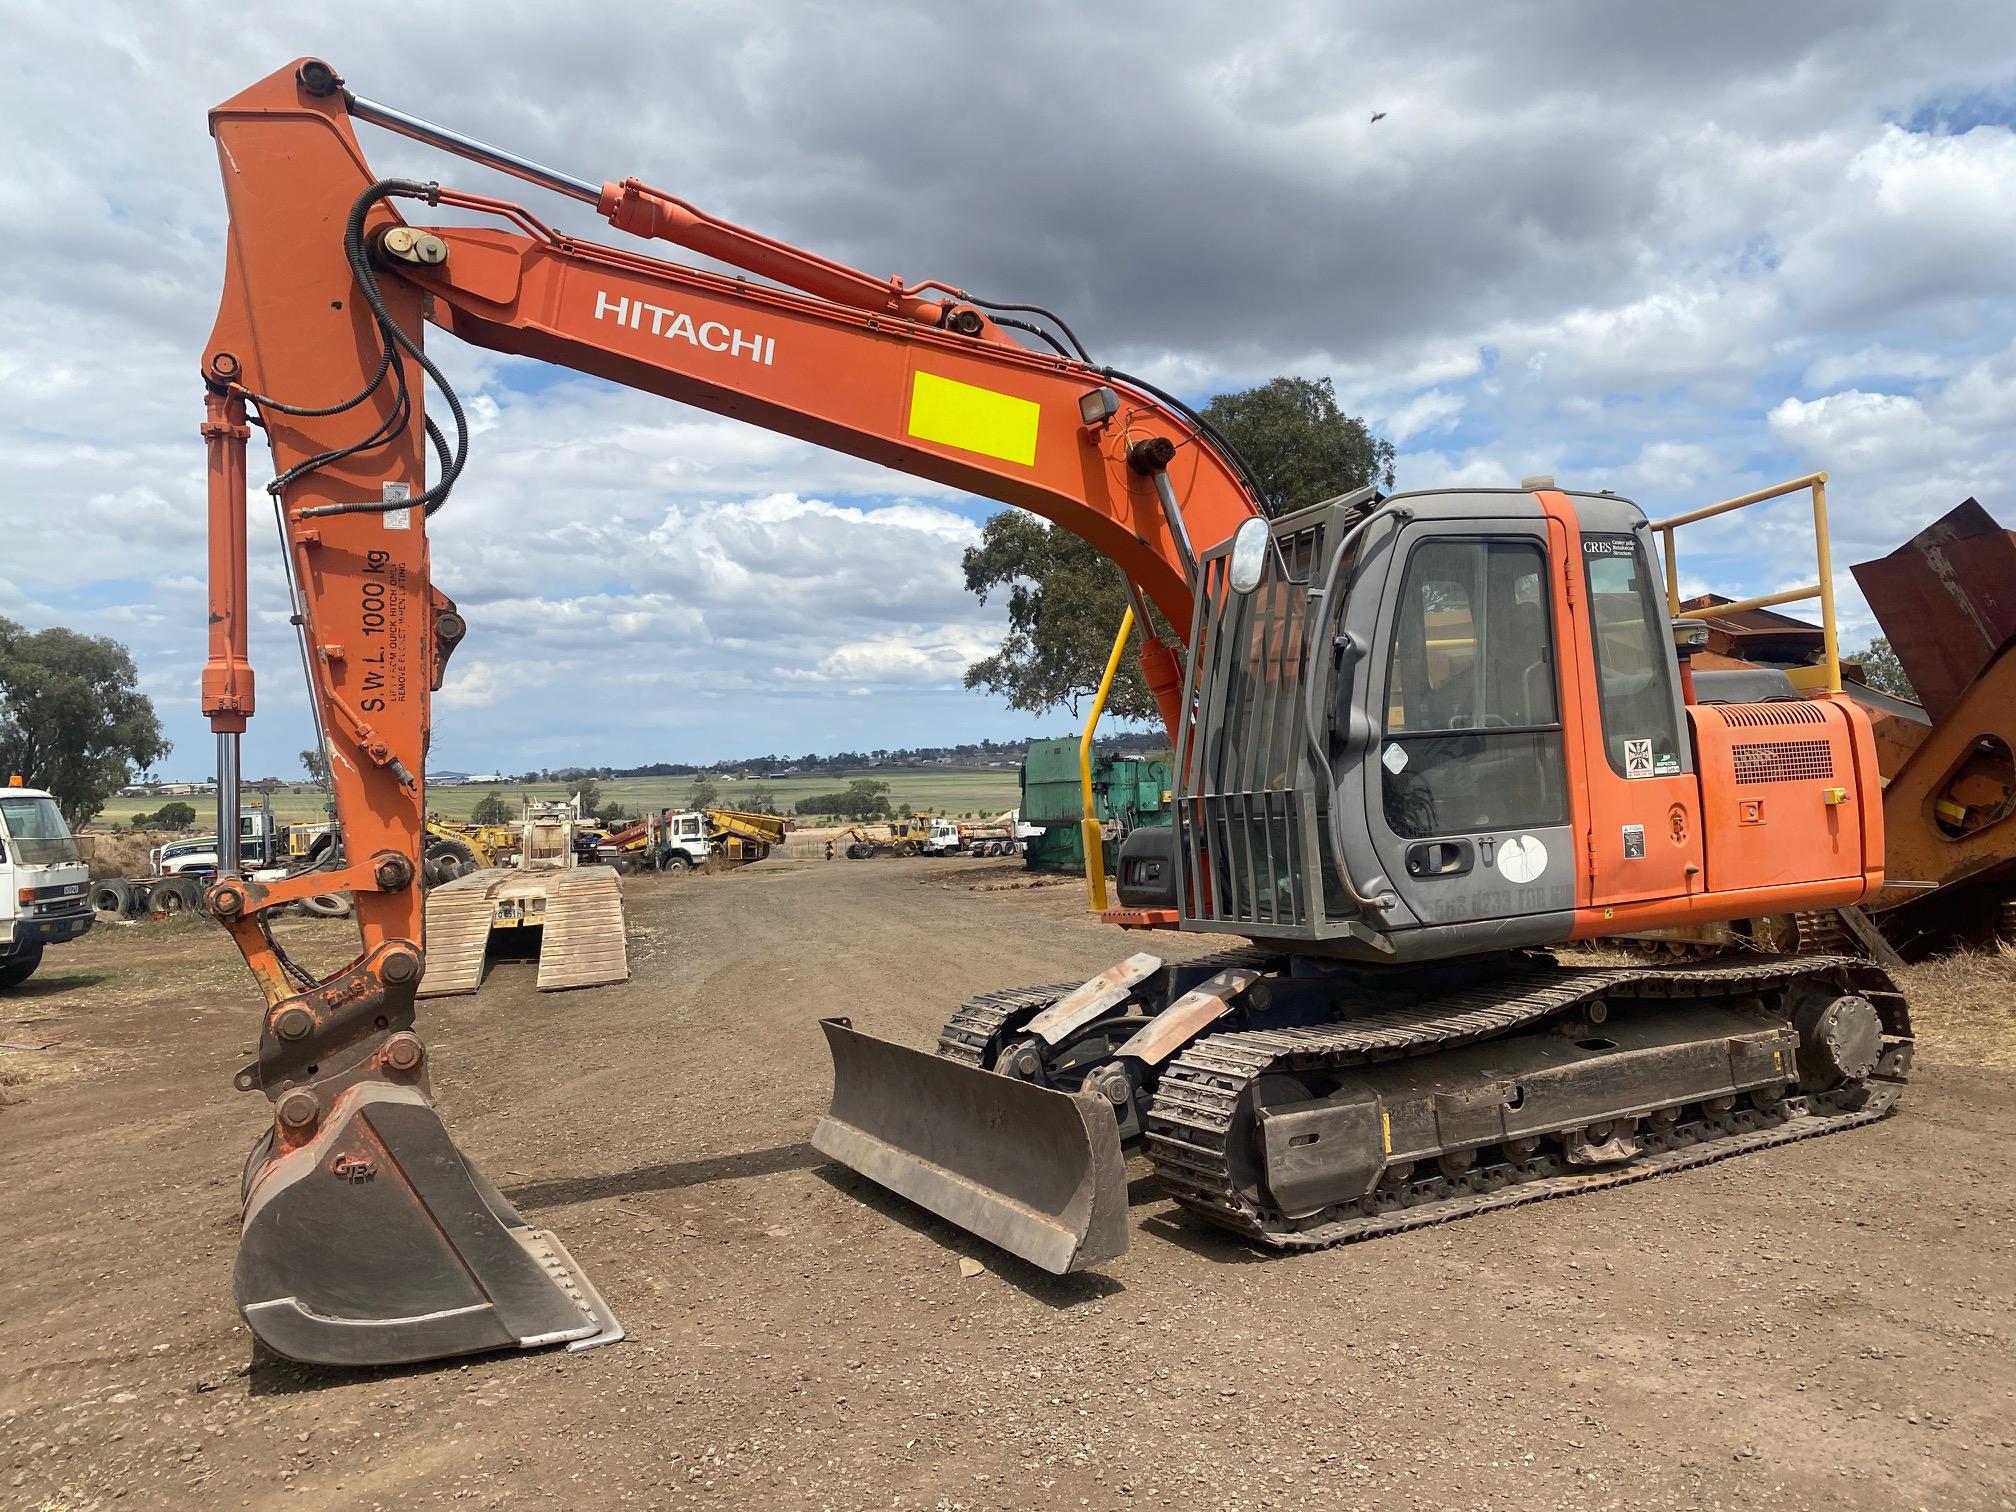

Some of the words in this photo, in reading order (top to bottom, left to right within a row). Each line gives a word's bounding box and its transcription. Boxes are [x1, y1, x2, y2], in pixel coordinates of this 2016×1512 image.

[594, 290, 775, 366] HITACHI
[1583, 541, 1612, 553] CRES
[362, 550, 390, 574] kg
[362, 582, 385, 636] 1000
[389, 589, 397, 616] HITCH
[389, 620, 397, 649] QUICK
[389, 652, 397, 678] ROM
[361, 646, 385, 712] S.W.L.
[389, 684, 397, 702] LIF
[64, 884, 78, 895] ISUZU
